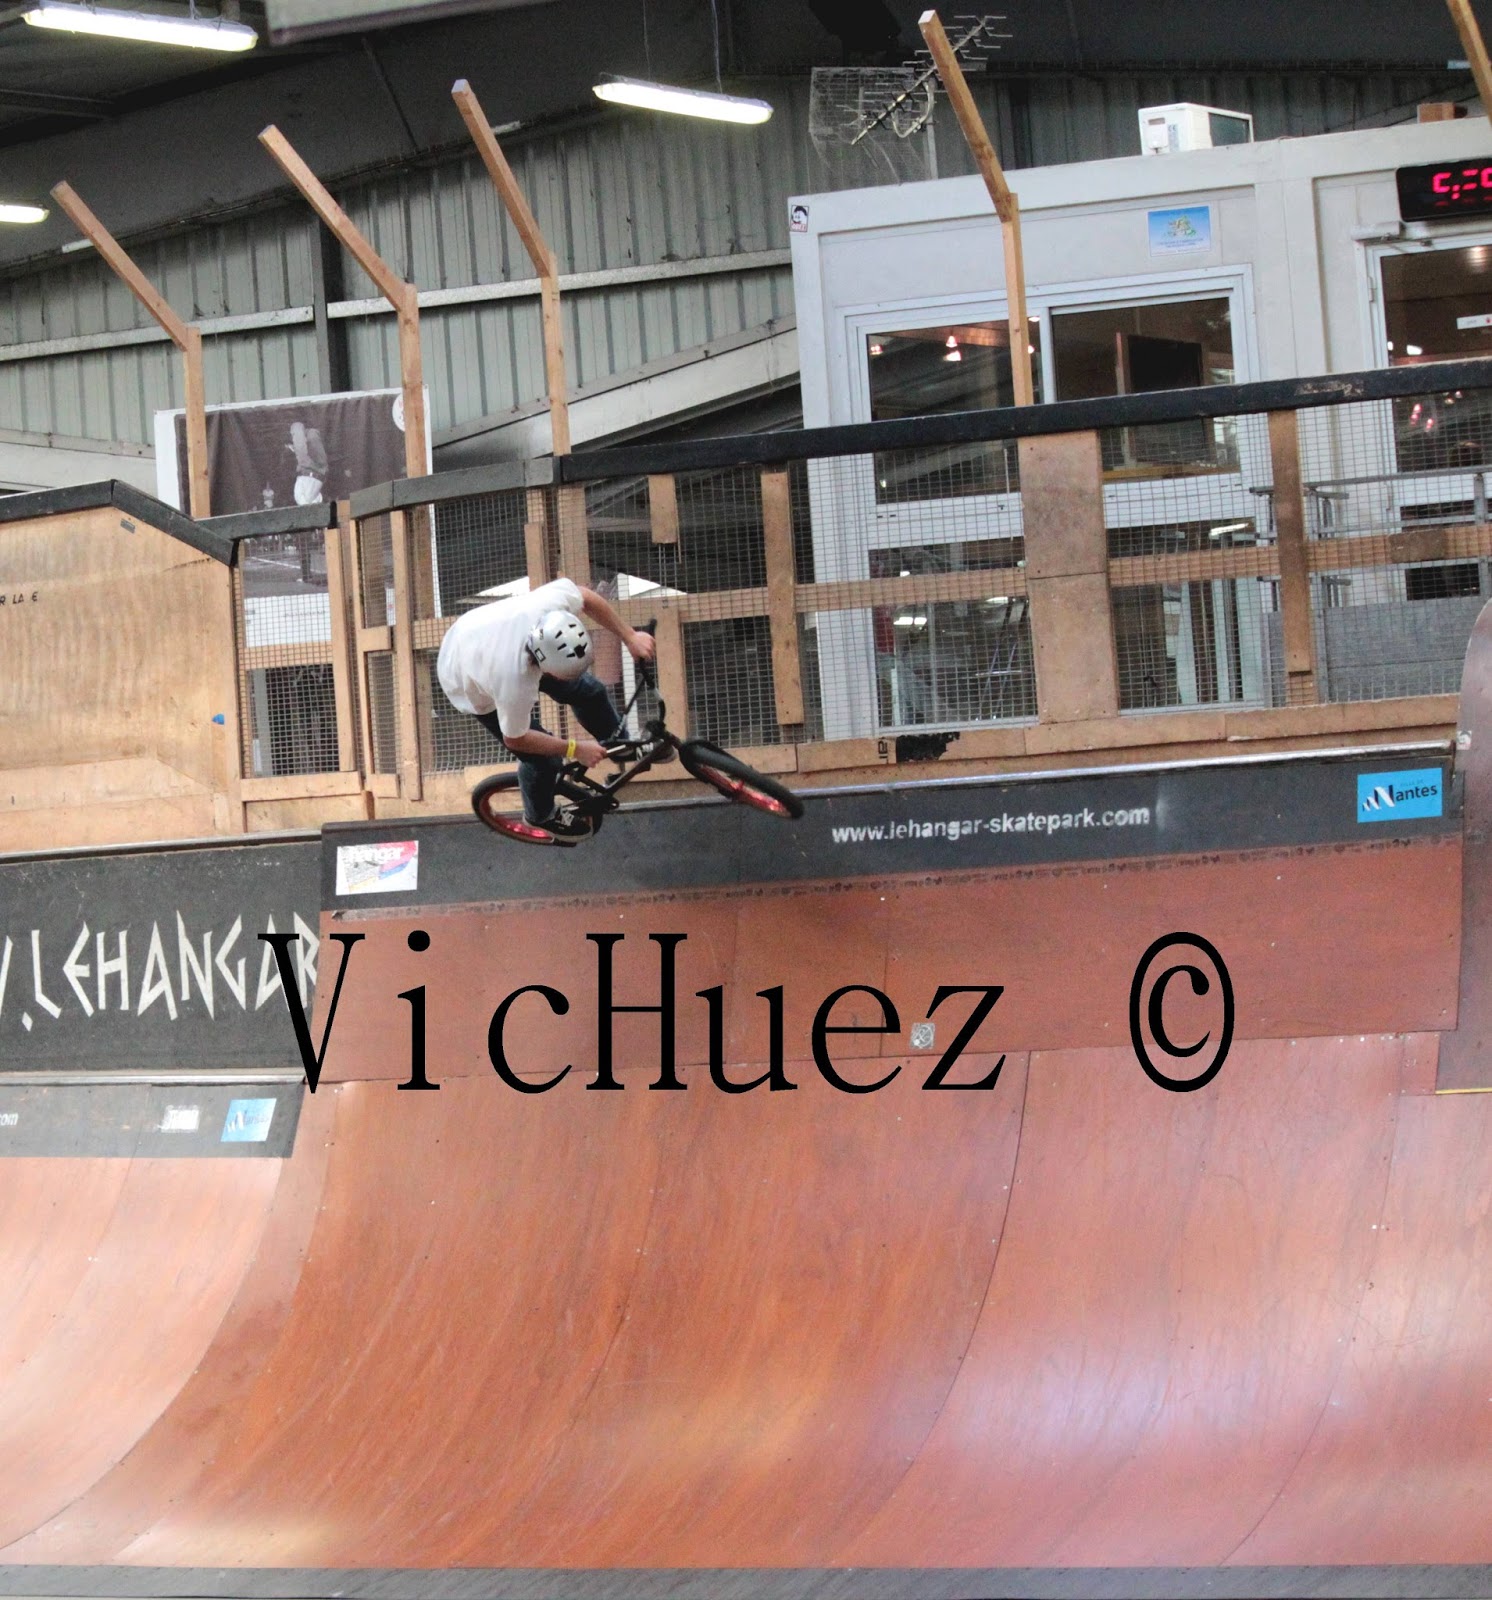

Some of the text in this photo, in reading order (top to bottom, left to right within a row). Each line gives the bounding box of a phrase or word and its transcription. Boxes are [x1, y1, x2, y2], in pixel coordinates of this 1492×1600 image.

[1362, 784, 1438, 811] Nantes
[832, 807, 1150, 844] www.lehangar-skatepark.com
[0, 909, 320, 1032] .LEHANGAR
